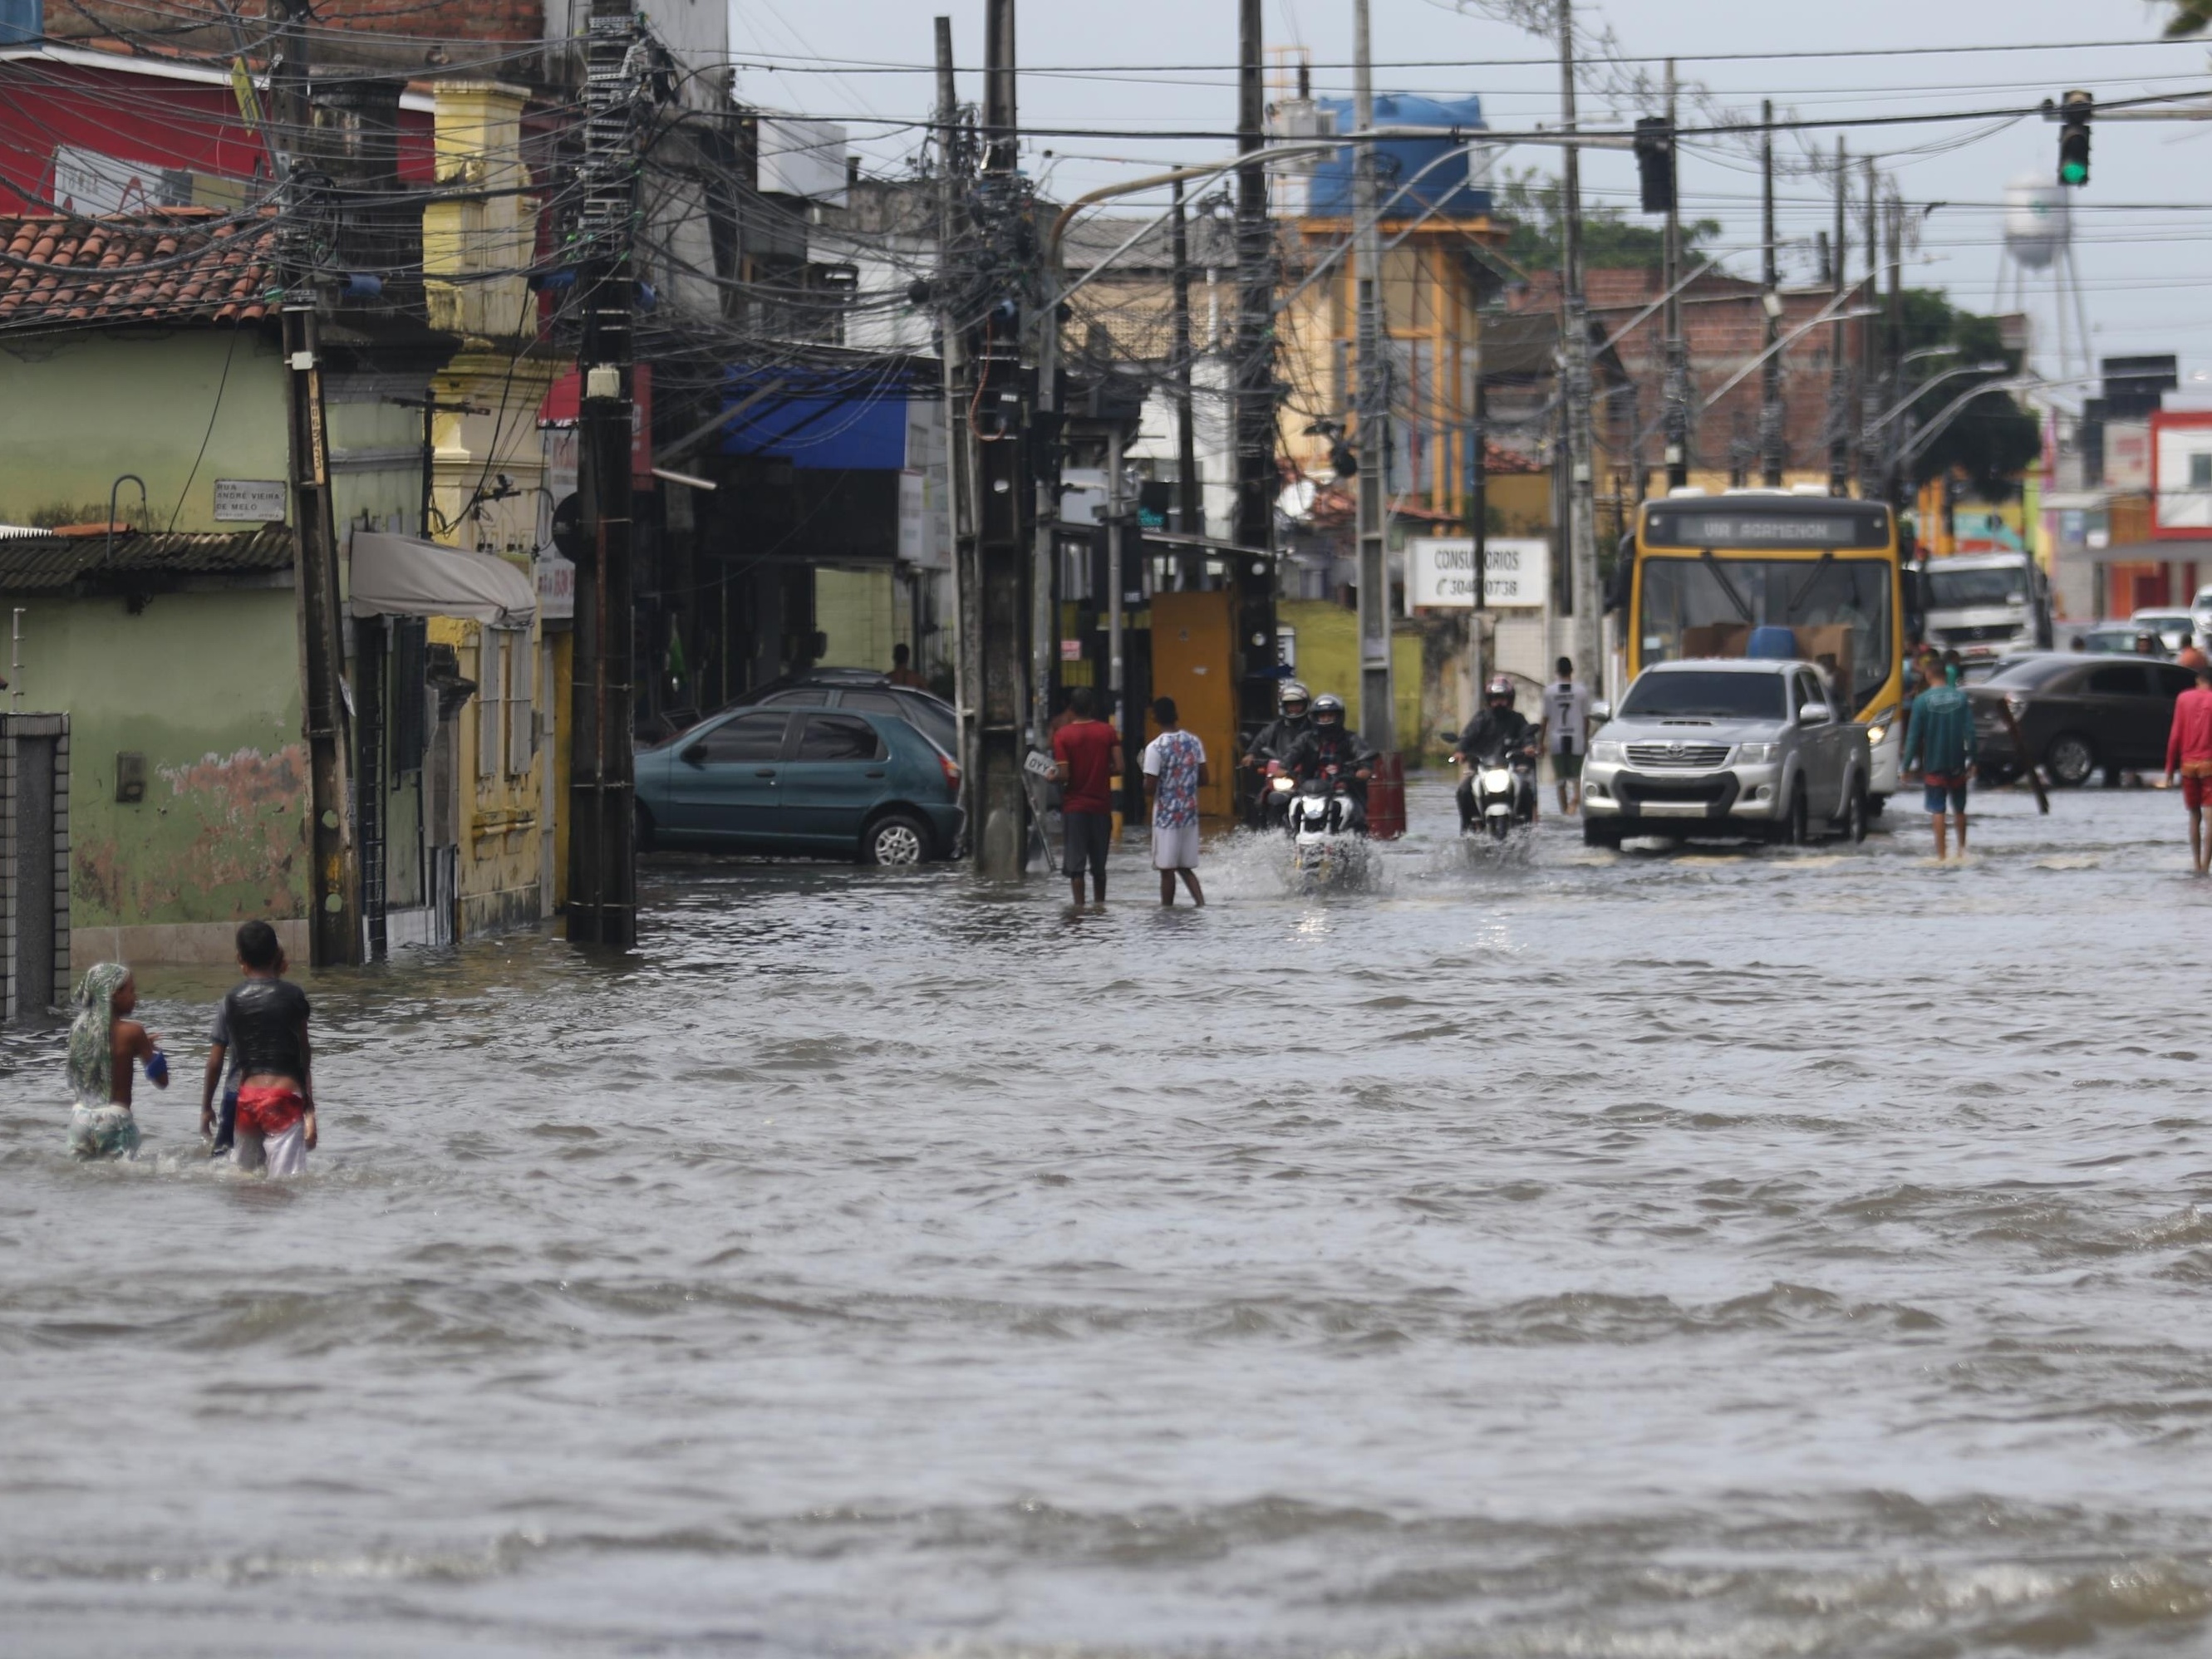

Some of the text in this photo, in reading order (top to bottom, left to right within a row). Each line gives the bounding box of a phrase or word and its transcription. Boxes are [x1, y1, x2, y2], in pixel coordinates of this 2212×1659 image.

[1704, 522, 1828, 539] VIA AGAMENON
[1558, 703, 1571, 726] 7
